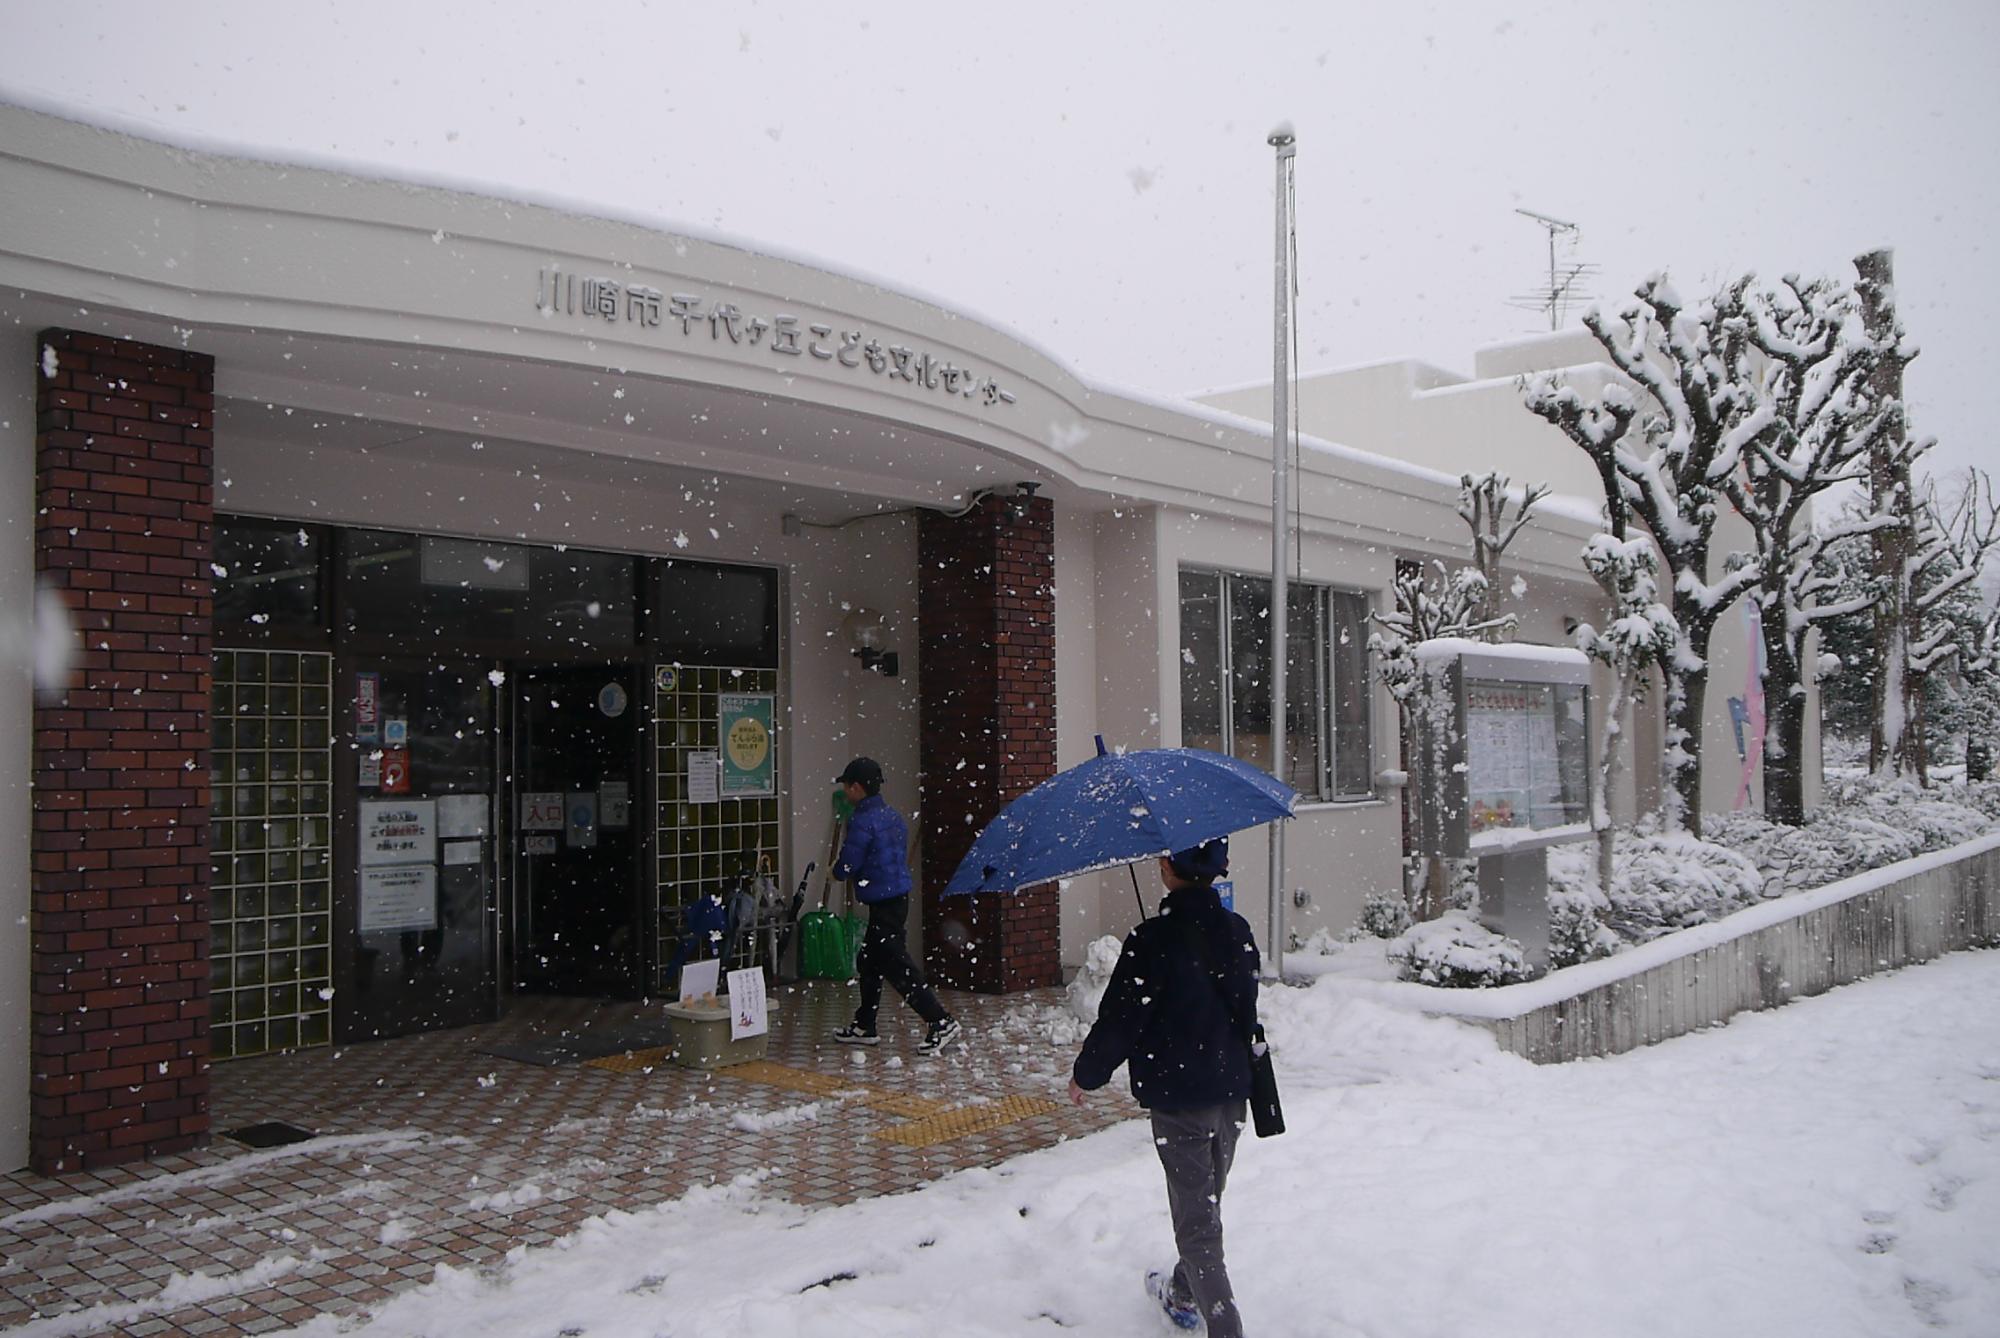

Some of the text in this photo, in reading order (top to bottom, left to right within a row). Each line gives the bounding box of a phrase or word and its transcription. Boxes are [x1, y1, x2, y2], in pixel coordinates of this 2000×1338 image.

[537, 268, 1017, 407] 川崎市千代ヶ丘こども文化センター
[528, 805, 561, 822] 入口
